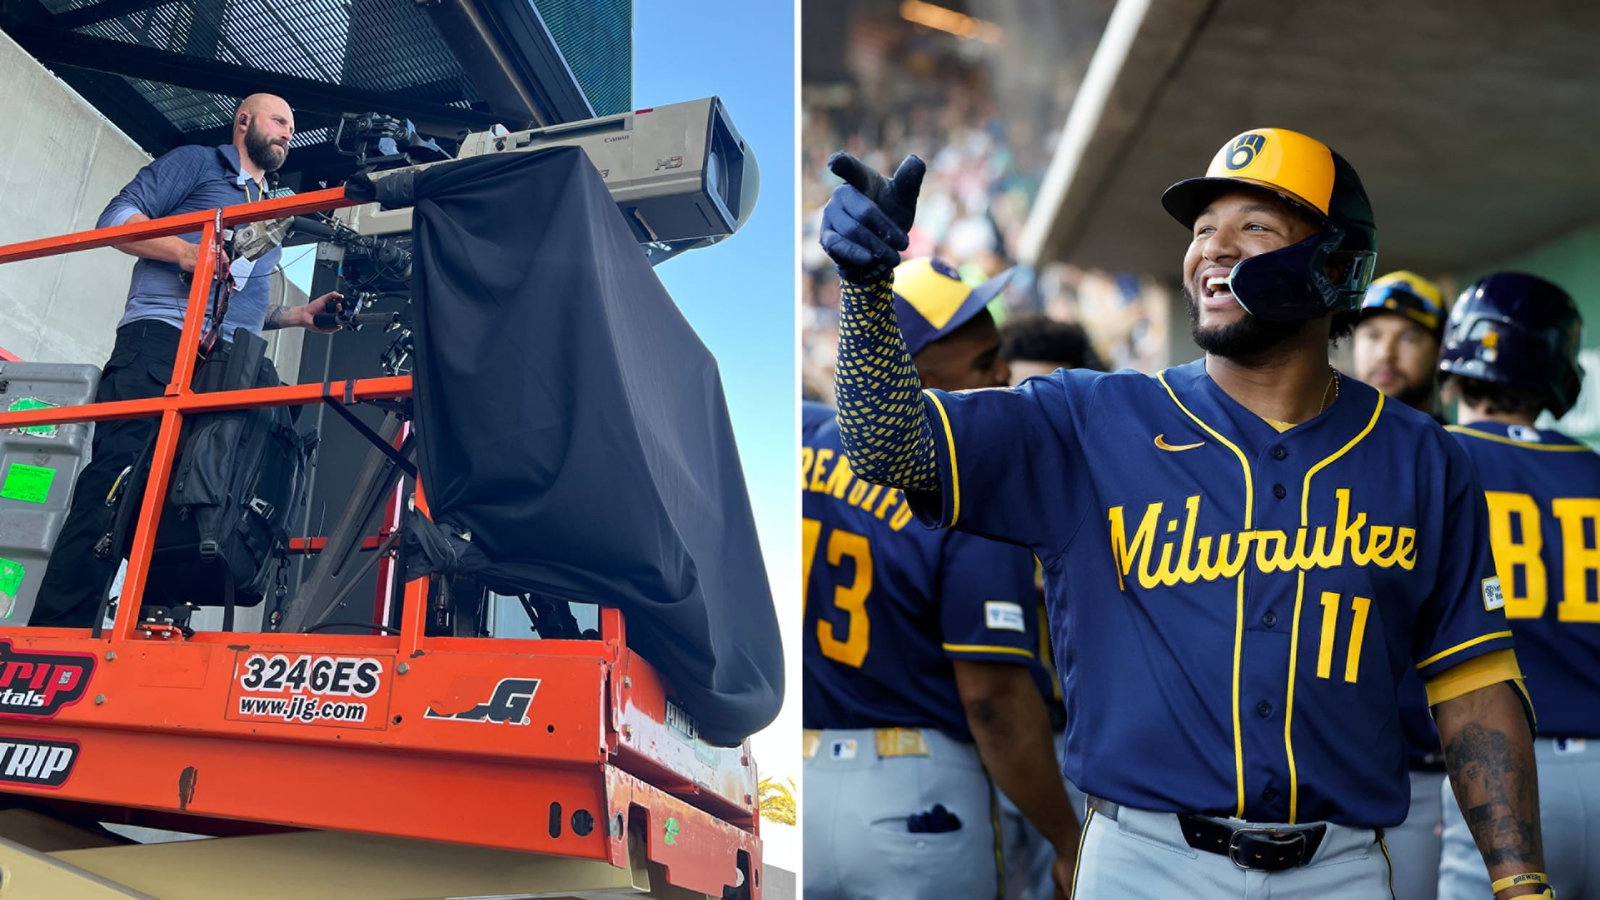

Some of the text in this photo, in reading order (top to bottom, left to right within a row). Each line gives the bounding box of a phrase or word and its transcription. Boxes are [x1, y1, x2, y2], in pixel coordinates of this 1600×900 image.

[604, 135, 629, 143] Canon
[1107, 487, 1418, 592] Milwaukee
[1315, 590, 1372, 684] 11
[242, 655, 381, 696] 3246ES
[0, 687, 47, 708] tals
[240, 696, 366, 722] www.jlg.com
